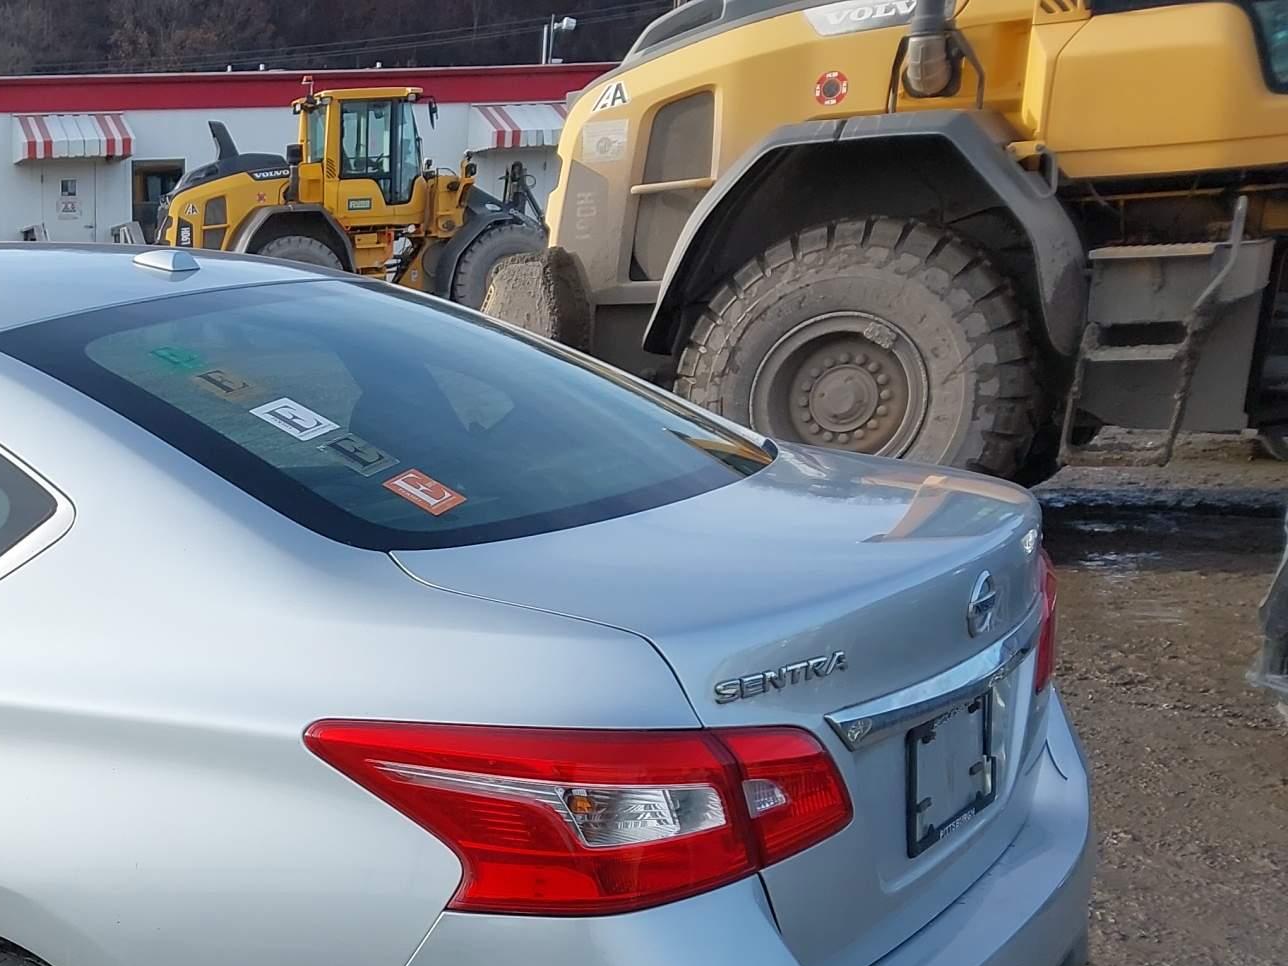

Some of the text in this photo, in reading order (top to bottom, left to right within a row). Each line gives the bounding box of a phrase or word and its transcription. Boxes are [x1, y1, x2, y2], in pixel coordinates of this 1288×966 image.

[825, 0, 917, 25] VOLV
[253, 169, 290, 178] VOLVO
[196, 370, 249, 393] E
[263, 404, 324, 433] E
[327, 437, 384, 467] E
[392, 473, 452, 506] E
[715, 650, 848, 704] SENTRA
